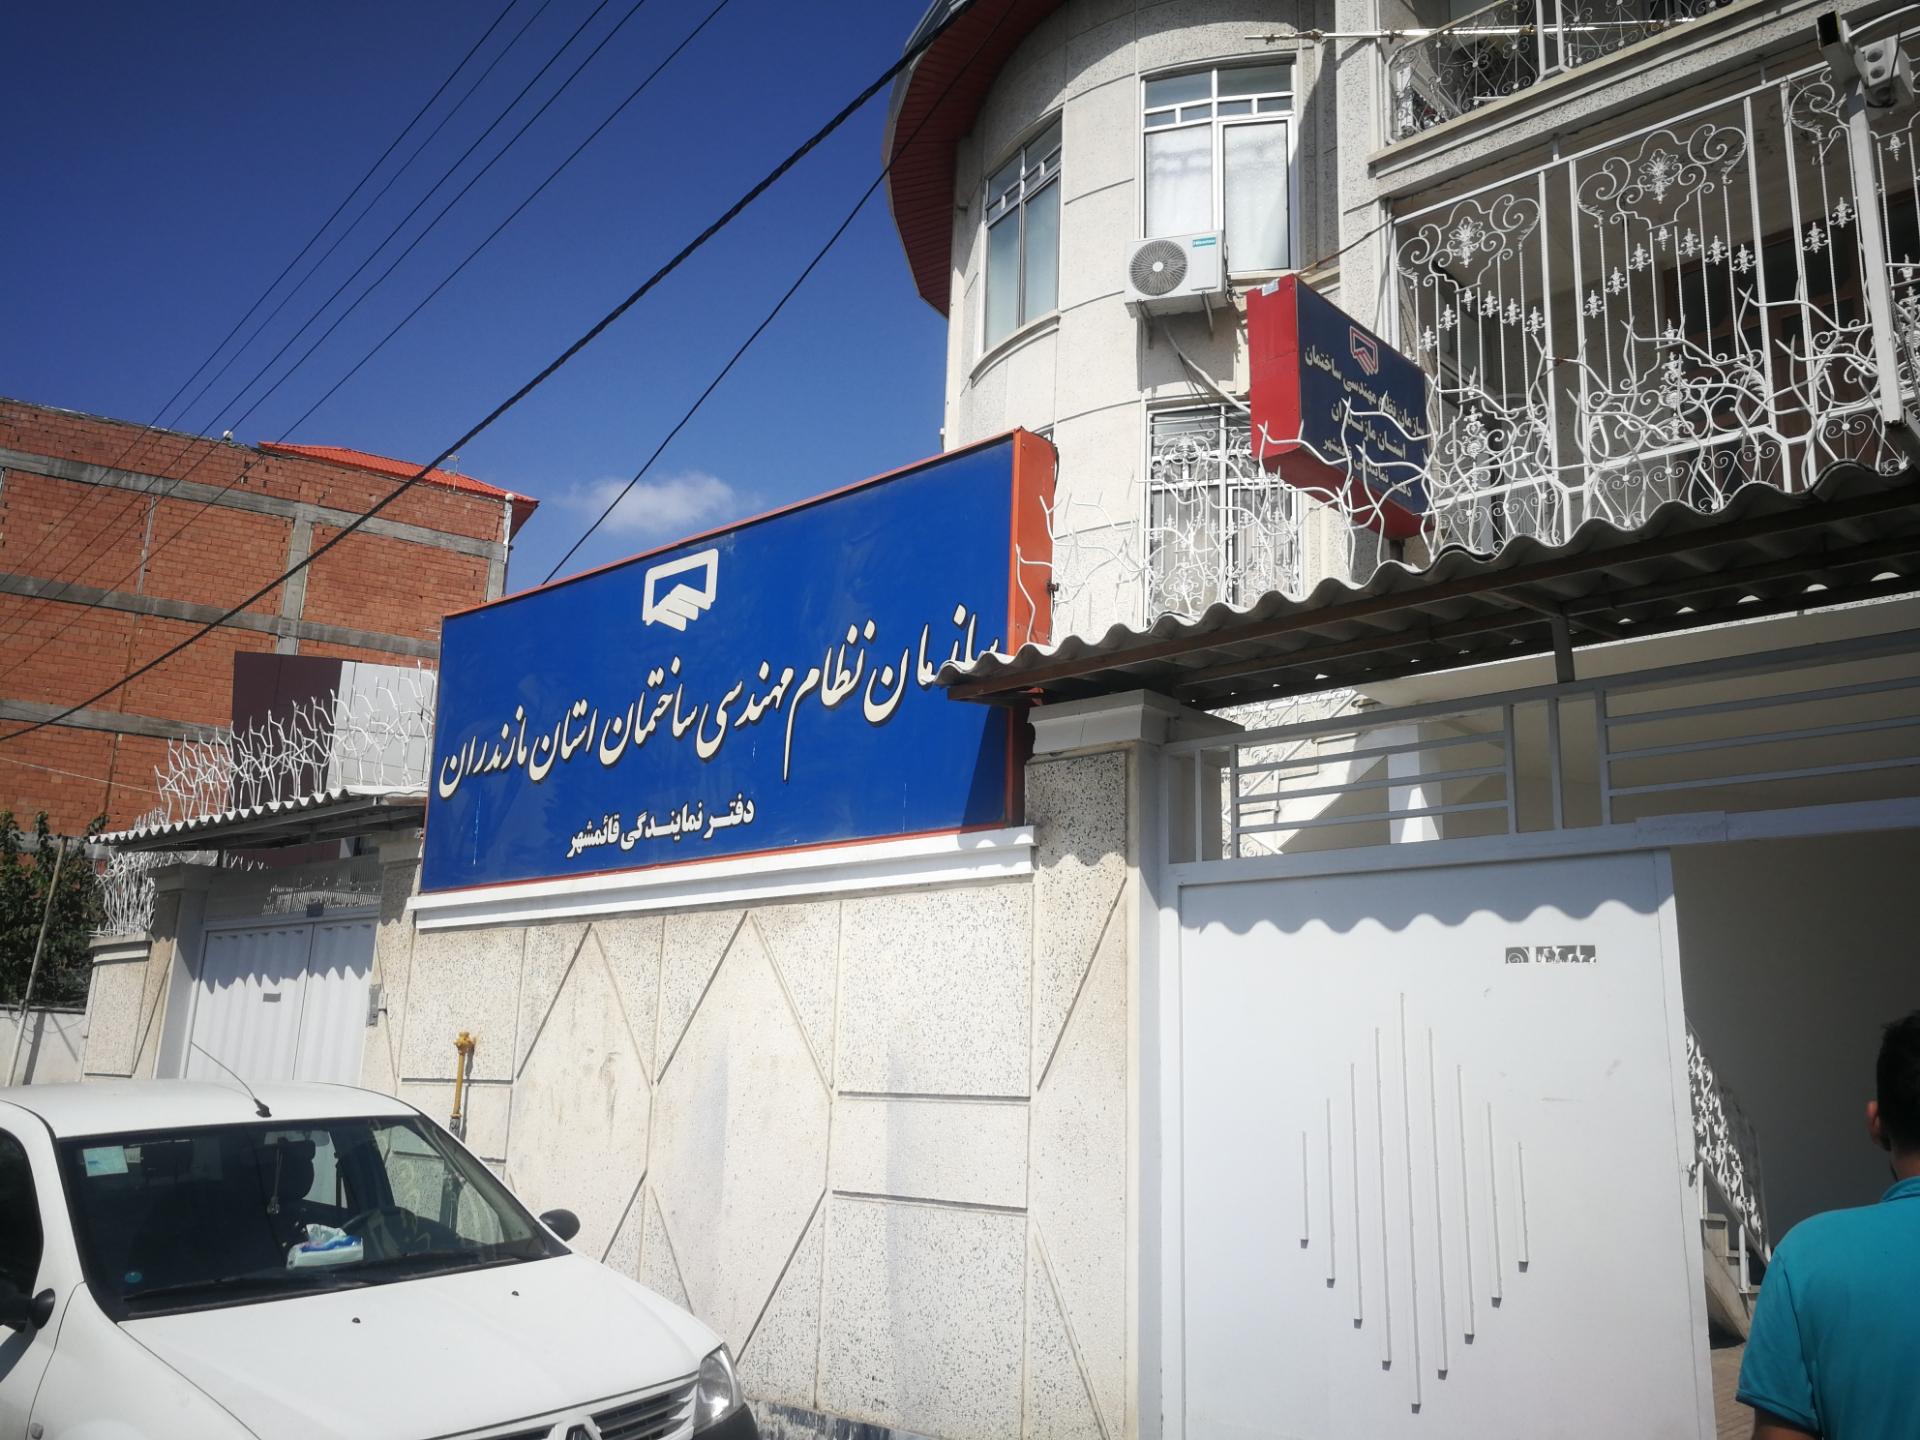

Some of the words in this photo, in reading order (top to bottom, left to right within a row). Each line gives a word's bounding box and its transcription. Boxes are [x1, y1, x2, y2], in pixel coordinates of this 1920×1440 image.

[1305, 344, 1342, 380] ساختمان
[1343, 378, 1377, 406] مهندسی
[1378, 430, 1406, 459] استان
[1397, 408, 1425, 438] سازمان
[599, 655, 698, 767] ساختمان
[696, 660, 795, 760] مهندسی
[782, 618, 877, 782] نظام
[438, 703, 528, 799] مازندران
[528, 699, 599, 782] استان
[566, 813, 621, 858] قائمشهر
[620, 801, 703, 851] نمایندگی
[703, 793, 755, 839] دفتر
